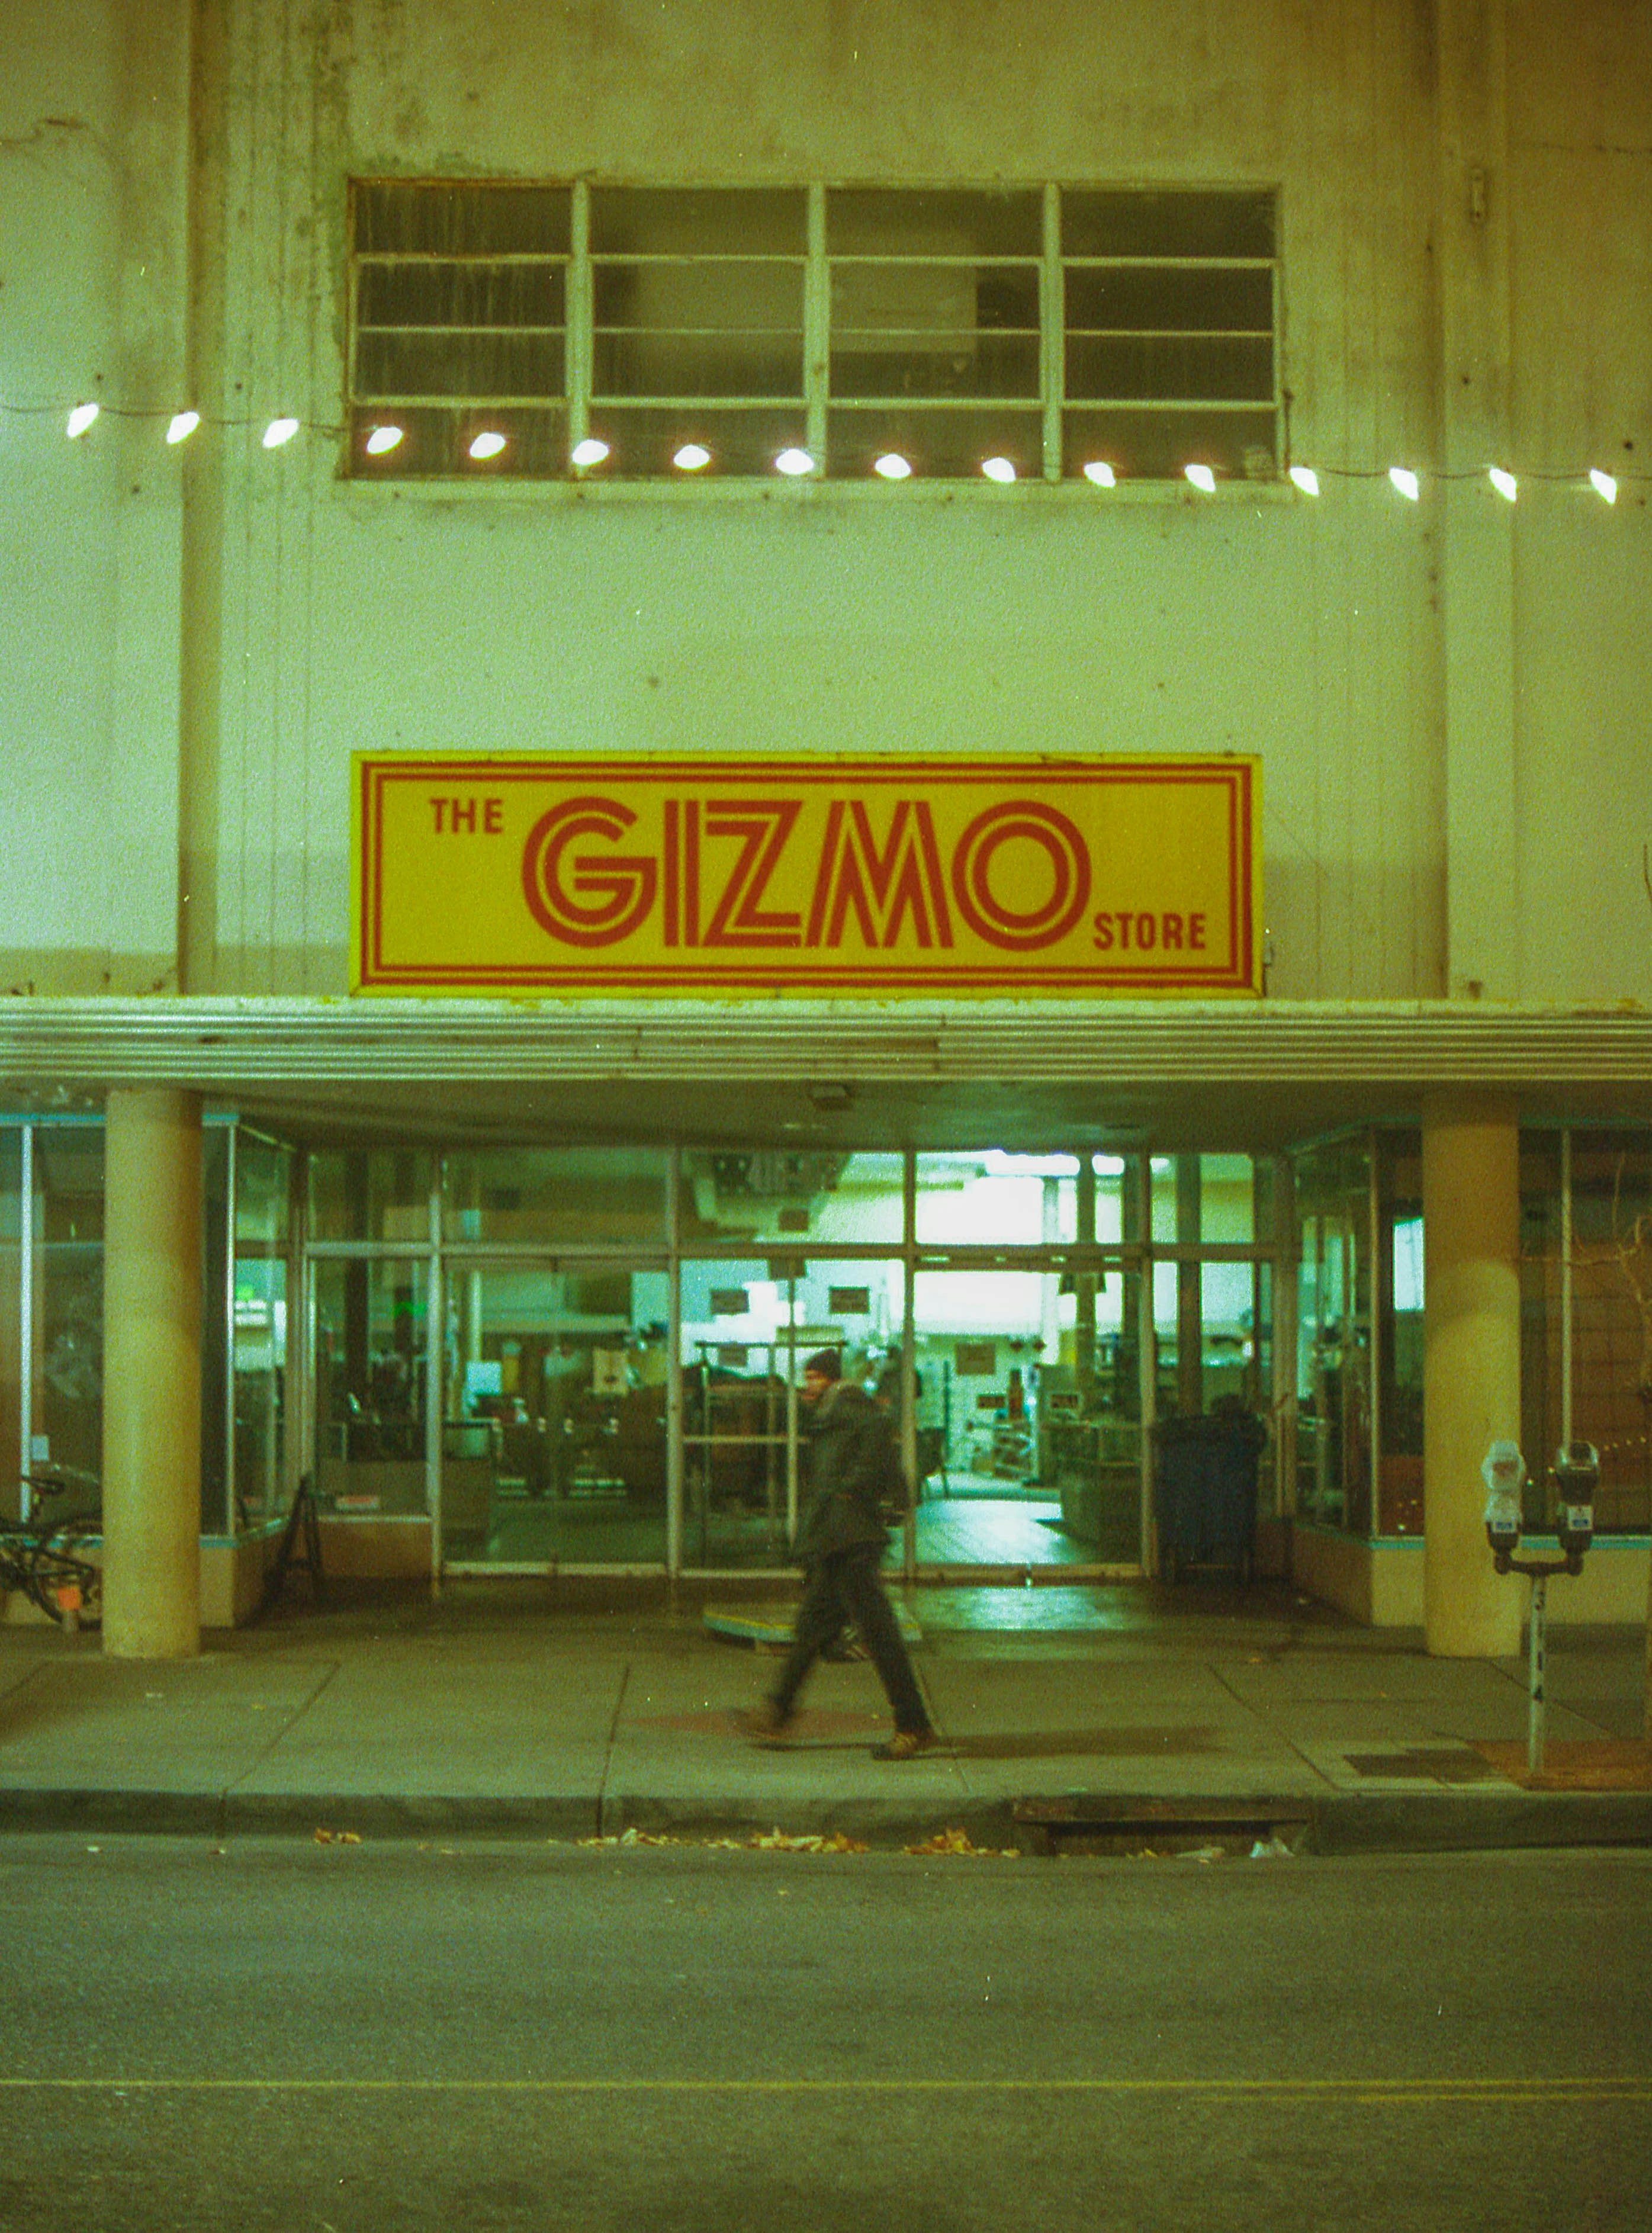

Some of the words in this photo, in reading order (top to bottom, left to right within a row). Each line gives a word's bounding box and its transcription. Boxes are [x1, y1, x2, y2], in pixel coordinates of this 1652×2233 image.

[429, 798, 503, 834] THE
[522, 796, 1091, 952] GIZMO
[1094, 913, 1207, 950] STORE
